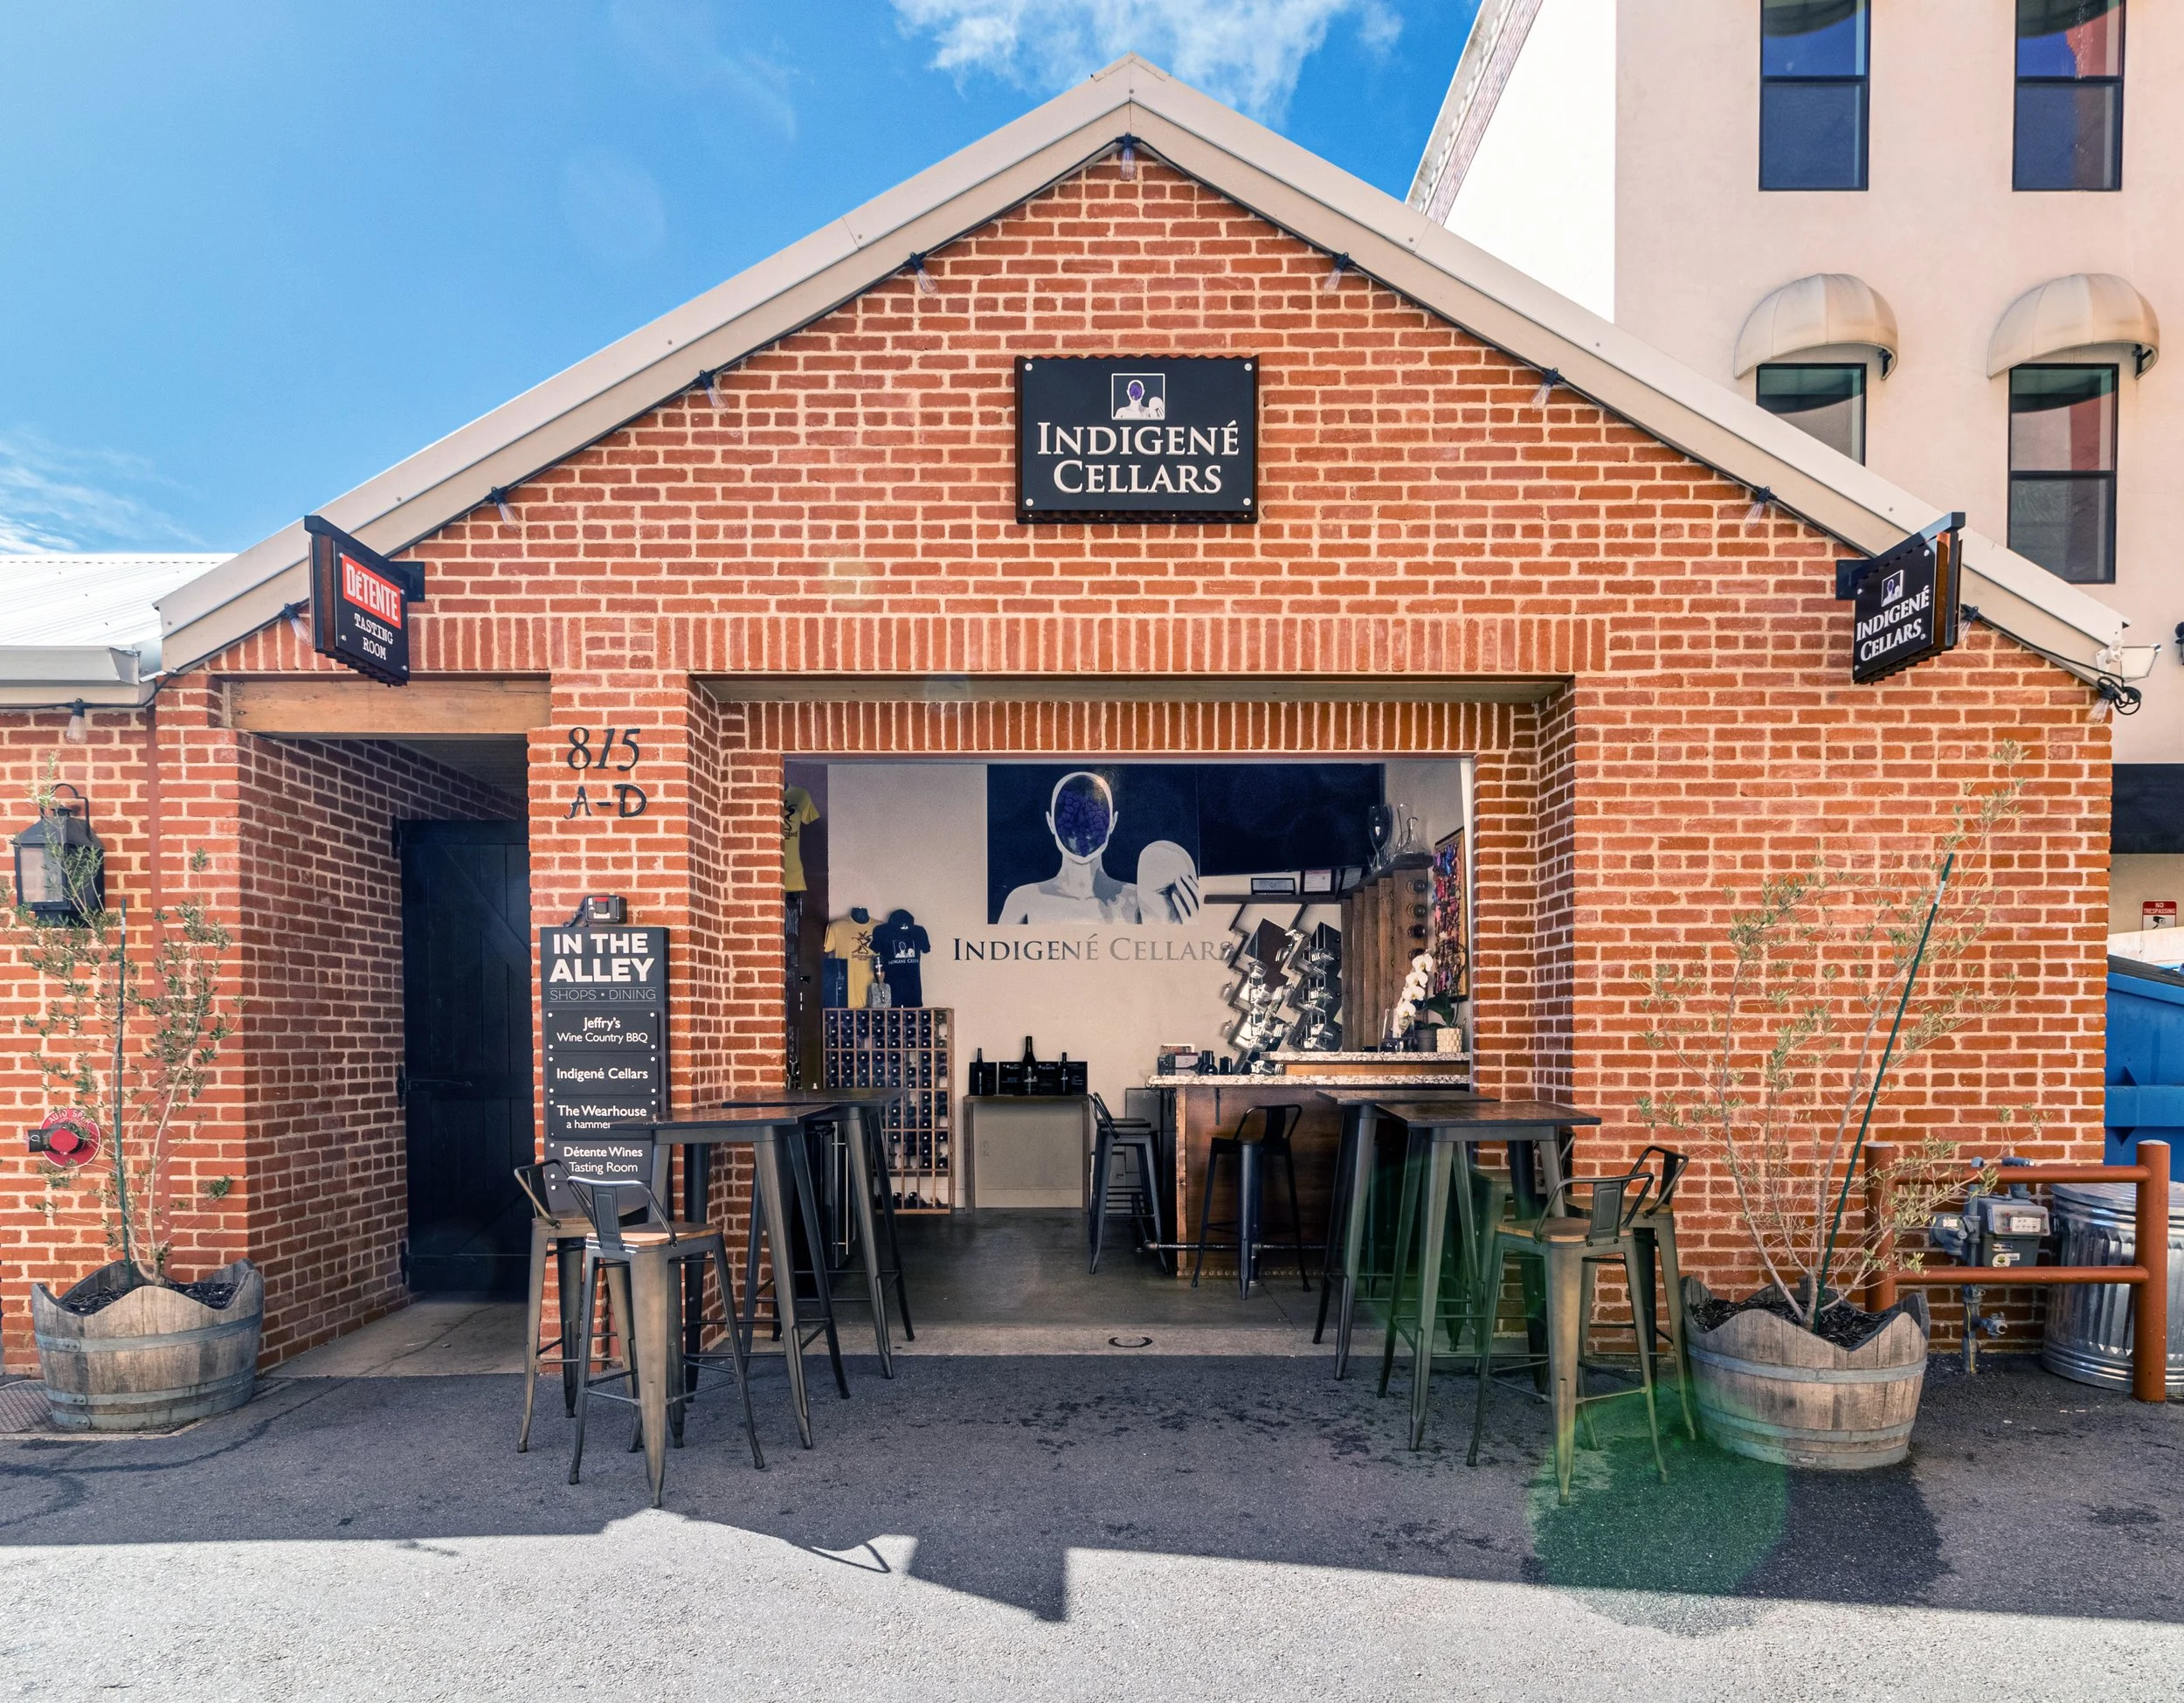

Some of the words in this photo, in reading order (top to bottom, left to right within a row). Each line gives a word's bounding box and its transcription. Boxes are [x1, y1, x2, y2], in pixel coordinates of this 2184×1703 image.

[1037, 419, 1240, 456] INDIGENÉ
[1053, 460, 1222, 495] CELLARS
[1856, 585, 1930, 642] INDIGENÉ
[354, 613, 393, 645] TASTING
[1860, 618, 1923, 662] CELLARS
[363, 636, 387, 661] ROOM
[567, 726, 640, 772] 815
[553, 933, 584, 954] IN
[591, 933, 648, 954] THE
[953, 933, 1099, 961] INDIGENÉ
[549, 958, 654, 983] ALLEY
[549, 989, 597, 1000] SHOPS
[609, 989, 656, 1000] DINING
[583, 1017, 621, 1032] Jeffry's
[556, 1033, 584, 1042] Wine
[585, 1033, 624, 1044] Country
[626, 1033, 648, 1043] BBQ
[556, 1068, 605, 1081] Indigené
[608, 1068, 648, 1079] Cellars
[557, 1105, 580, 1117] The
[581, 1105, 647, 1117] Wearhouse
[563, 1146, 607, 1158] Détente
[609, 1146, 643, 1158] Wines
[569, 1162, 604, 1174] Tasting
[606, 1162, 638, 1173] Room
